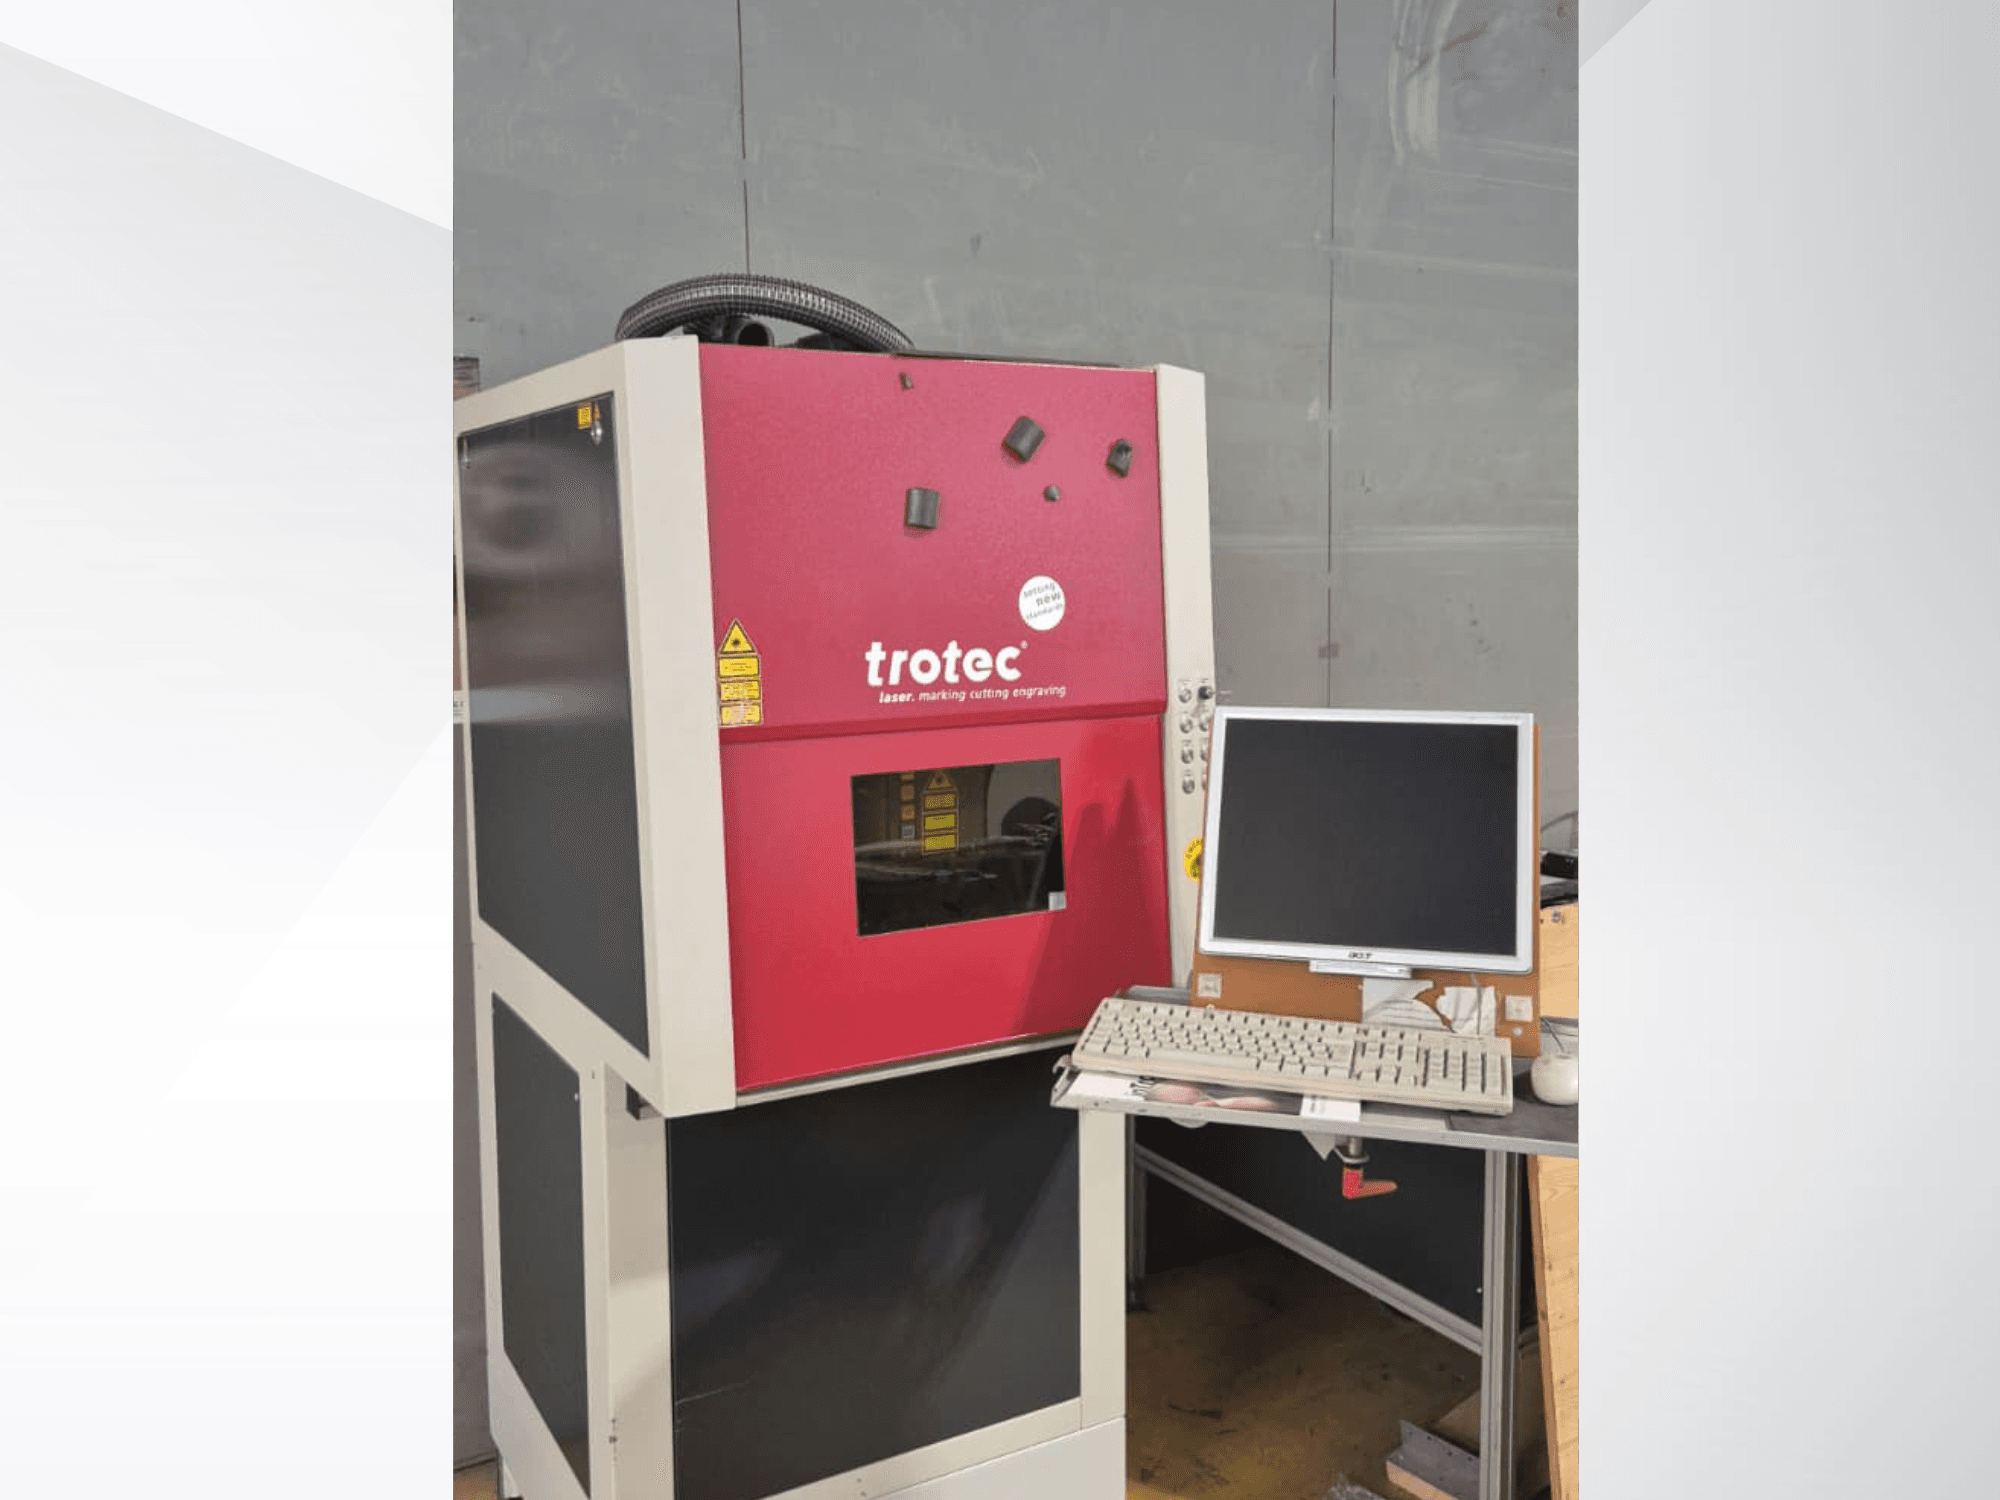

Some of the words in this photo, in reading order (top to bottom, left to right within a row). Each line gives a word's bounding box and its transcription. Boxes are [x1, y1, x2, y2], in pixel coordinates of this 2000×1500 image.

[1035, 591, 1061, 606] new
[865, 640, 1021, 687] trotec
[879, 690, 915, 703] laser.
[919, 688, 966, 702] marking
[969, 688, 1009, 700] cutting
[1013, 684, 1067, 698] engraving
